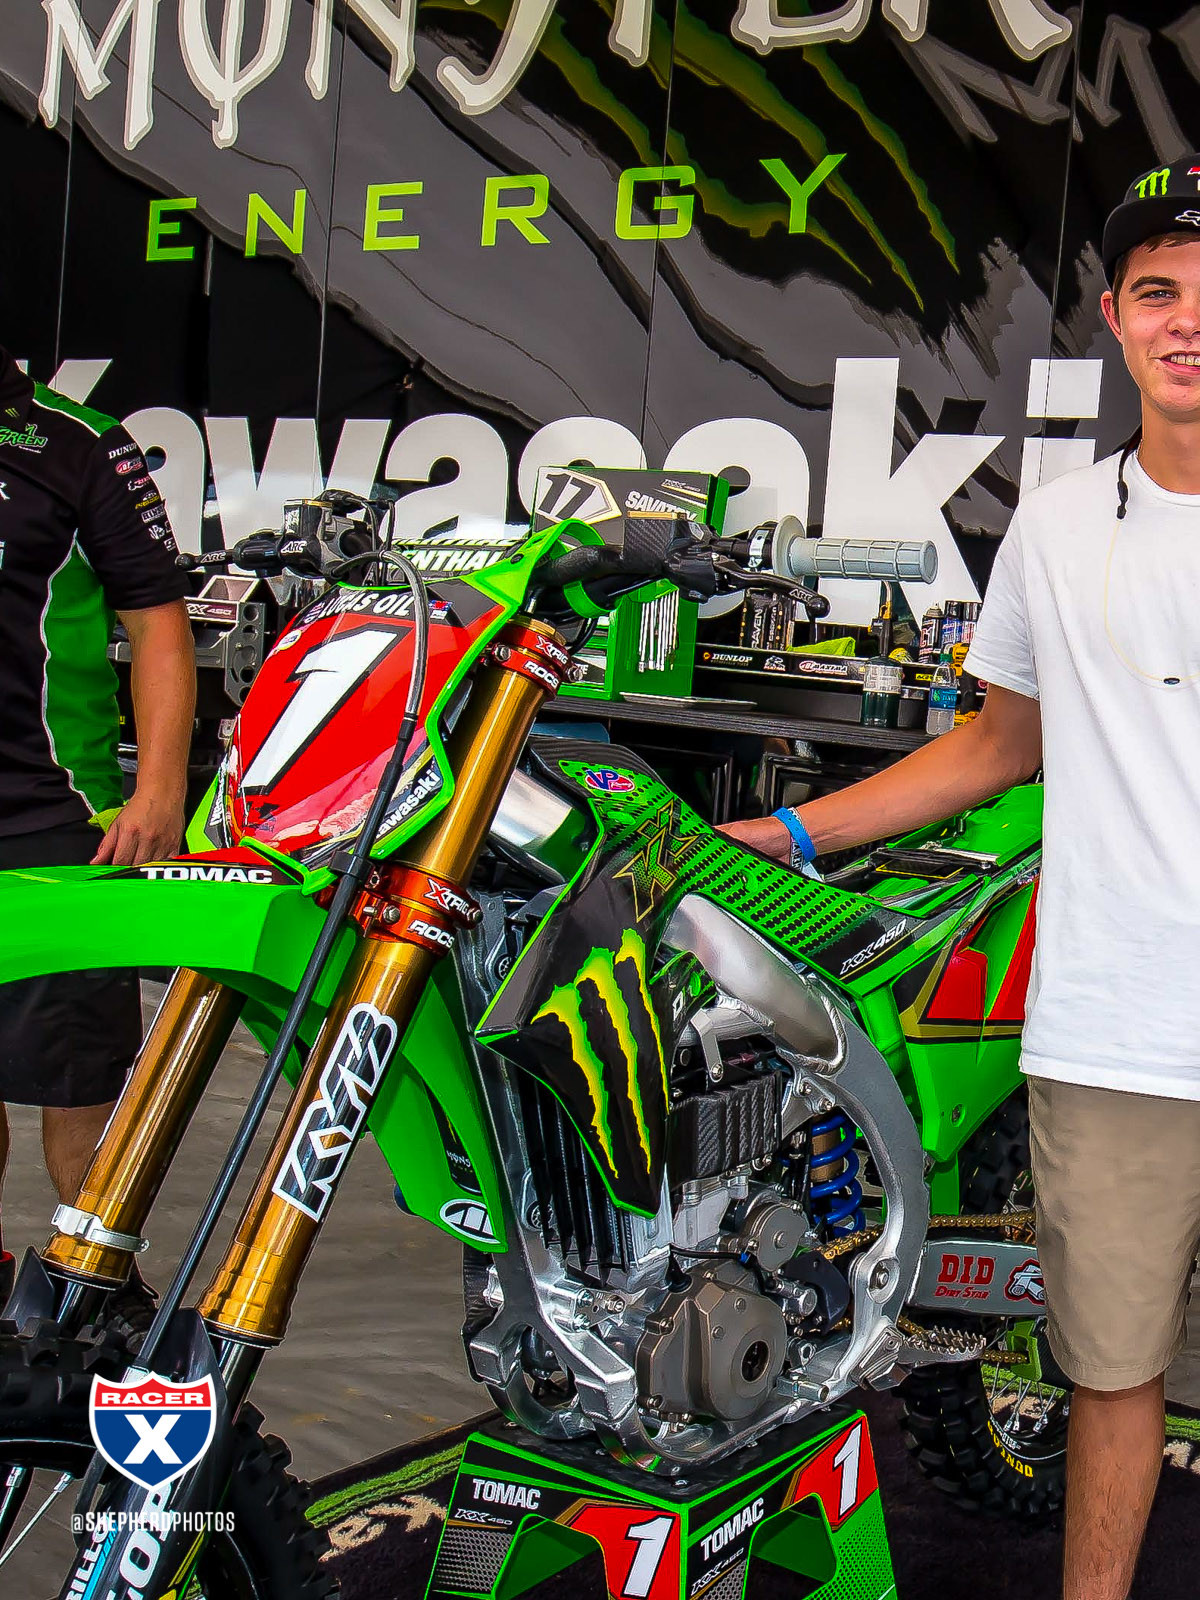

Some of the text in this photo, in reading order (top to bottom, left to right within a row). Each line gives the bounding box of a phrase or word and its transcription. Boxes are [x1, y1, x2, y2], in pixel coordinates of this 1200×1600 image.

[146, 152, 847, 261] ENERGY
[538, 473, 596, 521] 17
[201, 551, 226, 564] ARC
[281, 541, 307, 553] ARC
[318, 594, 373, 619] LUCAS
[371, 594, 415, 617] OIL
[536, 634, 569, 666] XTRIG
[711, 653, 753, 663] DUNLOP
[525, 661, 561, 689] ROCS
[240, 629, 398, 788] 1
[586, 768, 619, 791] VP
[375, 771, 440, 840] awasaki
[140, 866, 273, 884] TOMAC
[424, 878, 470, 915] XTRIG
[407, 919, 455, 949] ROCS
[832, 1423, 862, 1516] 1
[472, 1478, 541, 1510] TOMAC
[454, 1508, 490, 1523] KX
[700, 1497, 764, 1561] TOMAC
[622, 1516, 674, 1600] 1
[691, 1561, 723, 1596] KX
